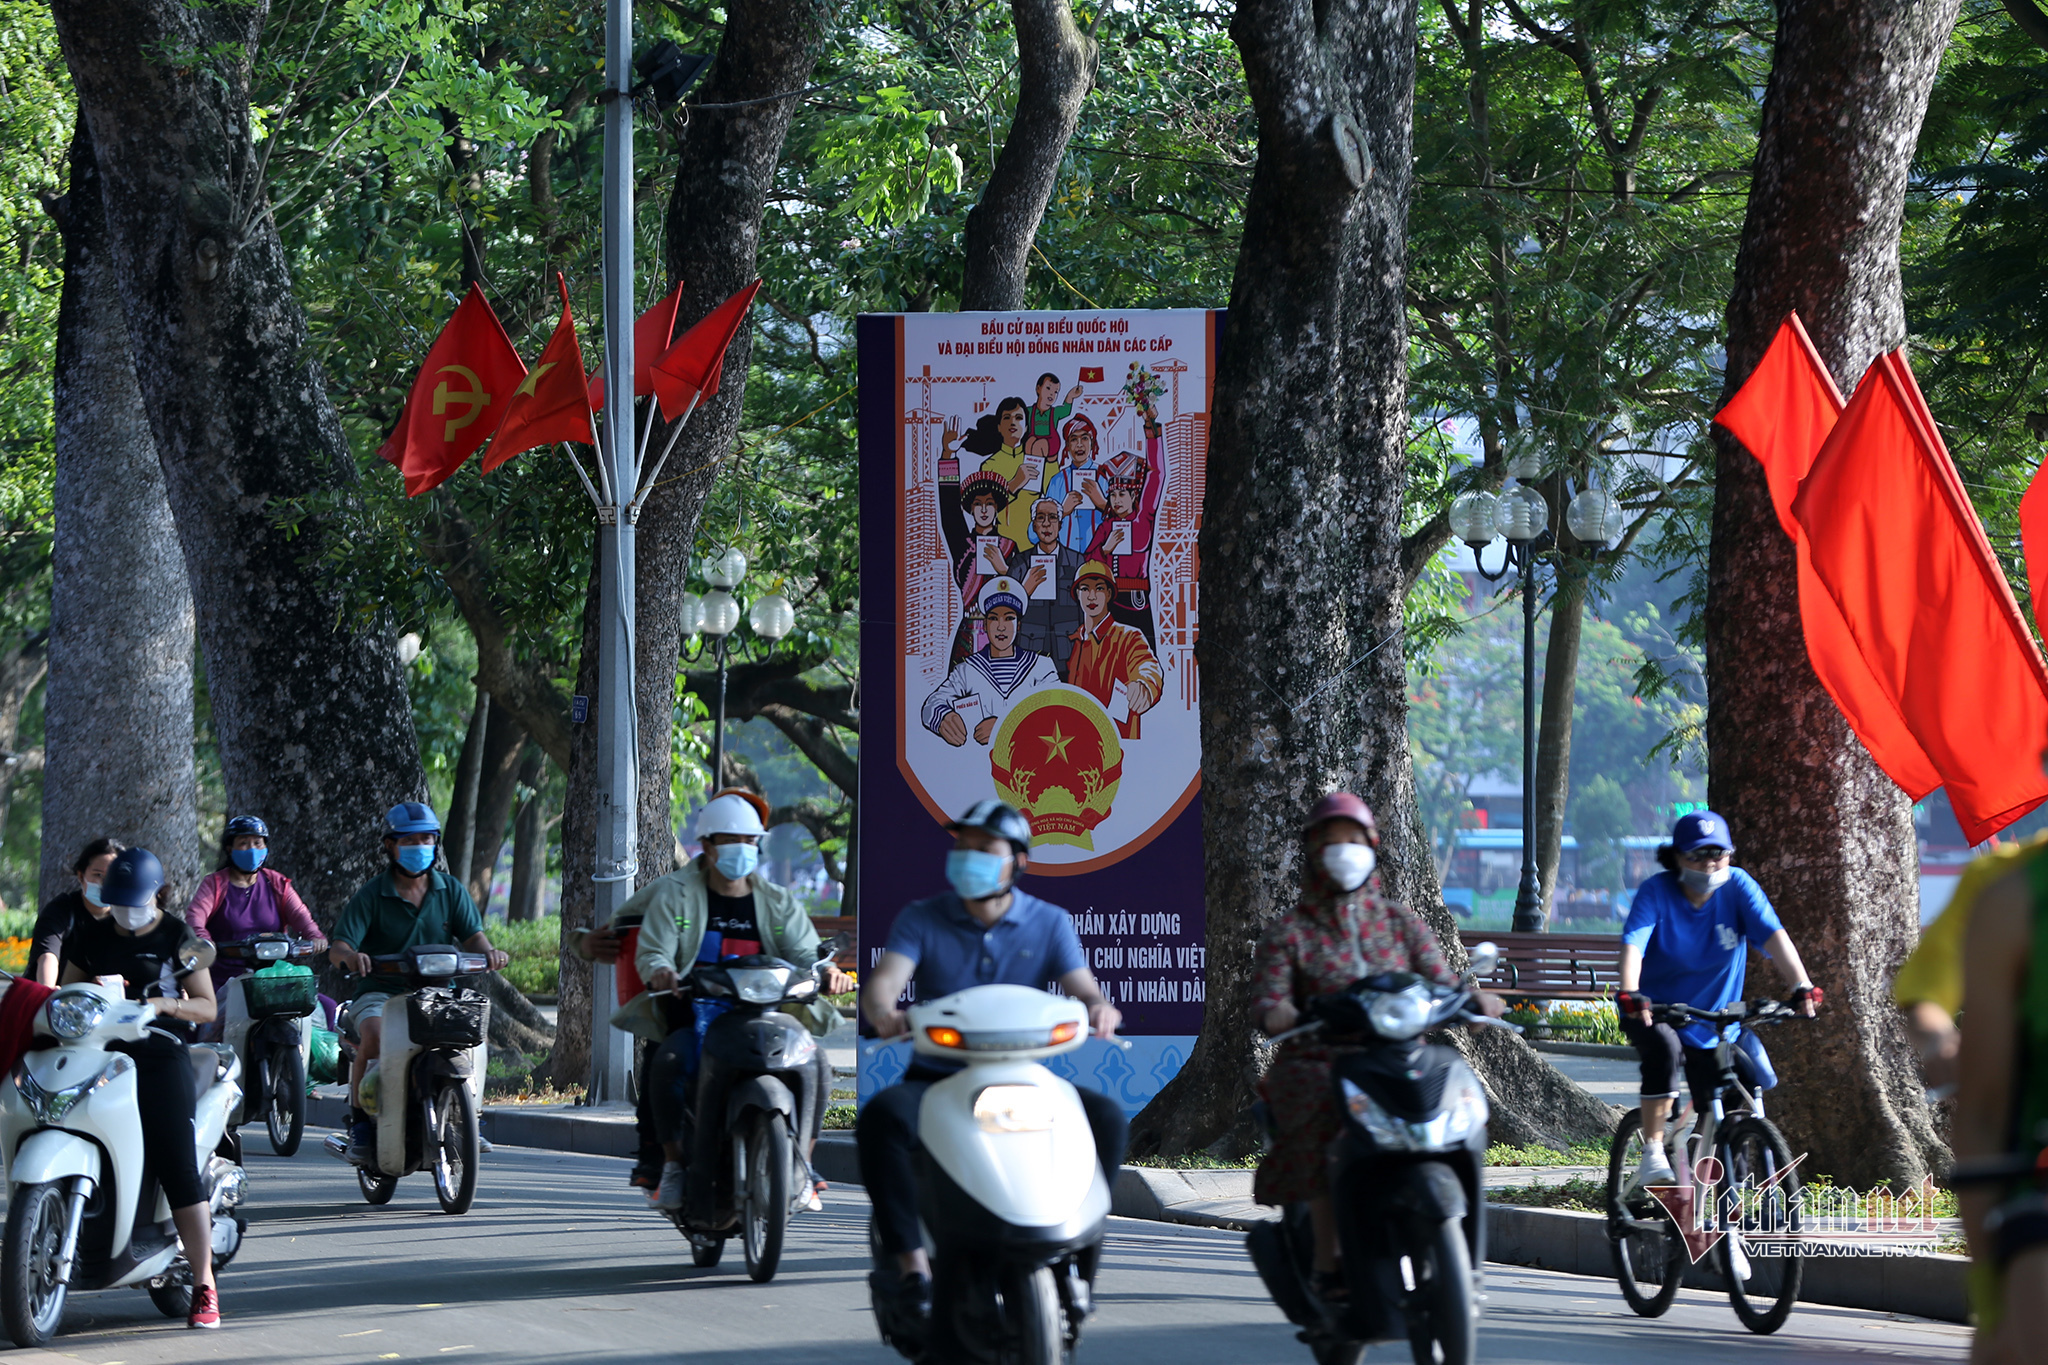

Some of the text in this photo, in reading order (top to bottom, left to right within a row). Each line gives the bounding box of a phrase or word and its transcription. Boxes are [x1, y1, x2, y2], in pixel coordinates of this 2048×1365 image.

[981, 316, 1129, 337] BẦU CỬ ĐẠI BIỂU QUỐC HỘI
[938, 334, 1173, 358] VÀ ĐẠI BIỂU HỘI ĐỒNG NHÂN DÂN CÁC CẤP
[1037, 822, 1076, 832] VIỆT NAM
[1108, 909, 1137, 935] XÂY
[1141, 911, 1181, 939] DỰNG
[1094, 938, 1123, 969] CHỦ
[1127, 943, 1172, 969] NGHĨA
[1176, 943, 1205, 973] VIỆT
[1120, 976, 1133, 1002] VÌ
[1137, 976, 1178, 1002] NHÂN
